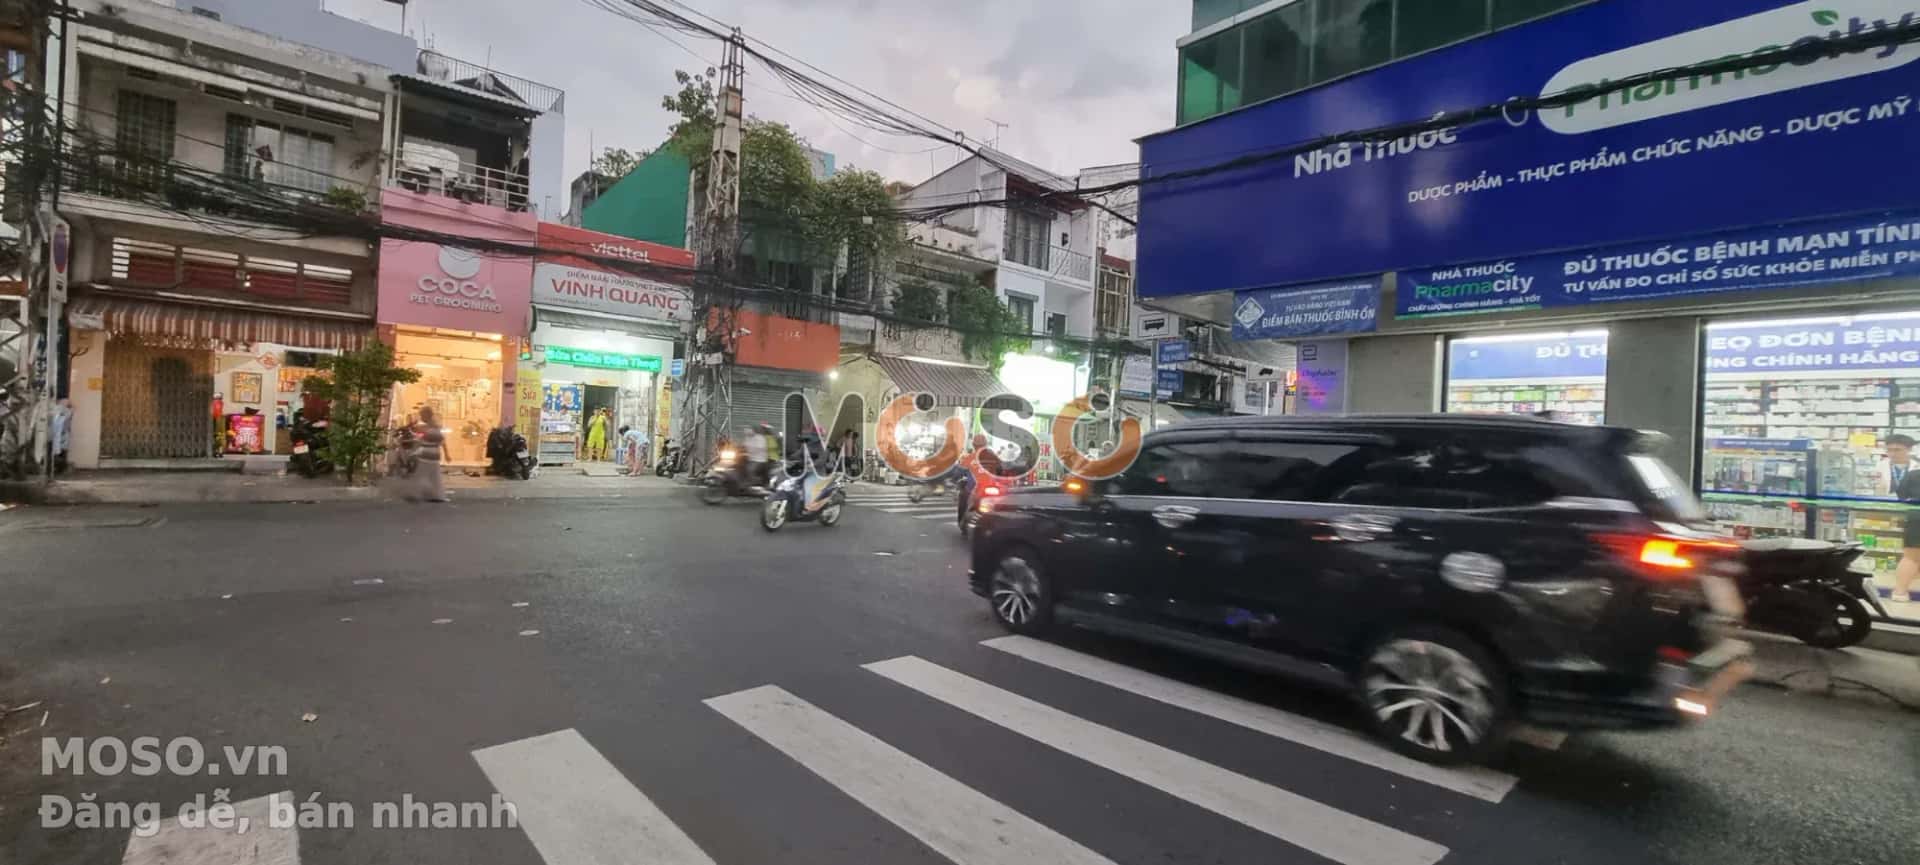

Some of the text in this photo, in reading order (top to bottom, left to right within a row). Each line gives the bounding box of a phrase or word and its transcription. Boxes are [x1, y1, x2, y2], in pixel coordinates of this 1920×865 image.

[1455, 170, 1503, 194] PHẨM
[1518, 162, 1565, 182] THỰC
[1569, 146, 1627, 174] PHẨM
[1632, 138, 1691, 163] CHỨC
[1696, 125, 1765, 151] NĂNG
[1786, 107, 1861, 135] DƯỢC
[1867, 95, 1912, 121] MỸ
[1564, 254, 1597, 276] ĐỦ
[1601, 245, 1689, 272] THUỐC
[1694, 240, 1769, 264] BỆNH
[1777, 231, 1849, 255] MẠN
[1431, 260, 1517, 282] NHÀ THUỐC
[1563, 280, 1585, 294] TƯ
[1587, 275, 1621, 292] VẤN
[1624, 275, 1653, 289] ĐO
[1655, 268, 1688, 285] CHỈ
[1691, 265, 1718, 282] SỐ
[1722, 264, 1761, 280] SỨC
[1765, 256, 1825, 276] KHỎE
[1829, 249, 1889, 270] MIỄN
[417, 275, 497, 299] COCA
[551, 279, 603, 300] VINH
[608, 287, 680, 311] QUANG
[1302, 309, 1334, 323] THUỐC
[1335, 308, 1360, 321] BÌNH
[1759, 330, 1835, 349] ĐƠN
[1752, 351, 1833, 367] CHÍNH
